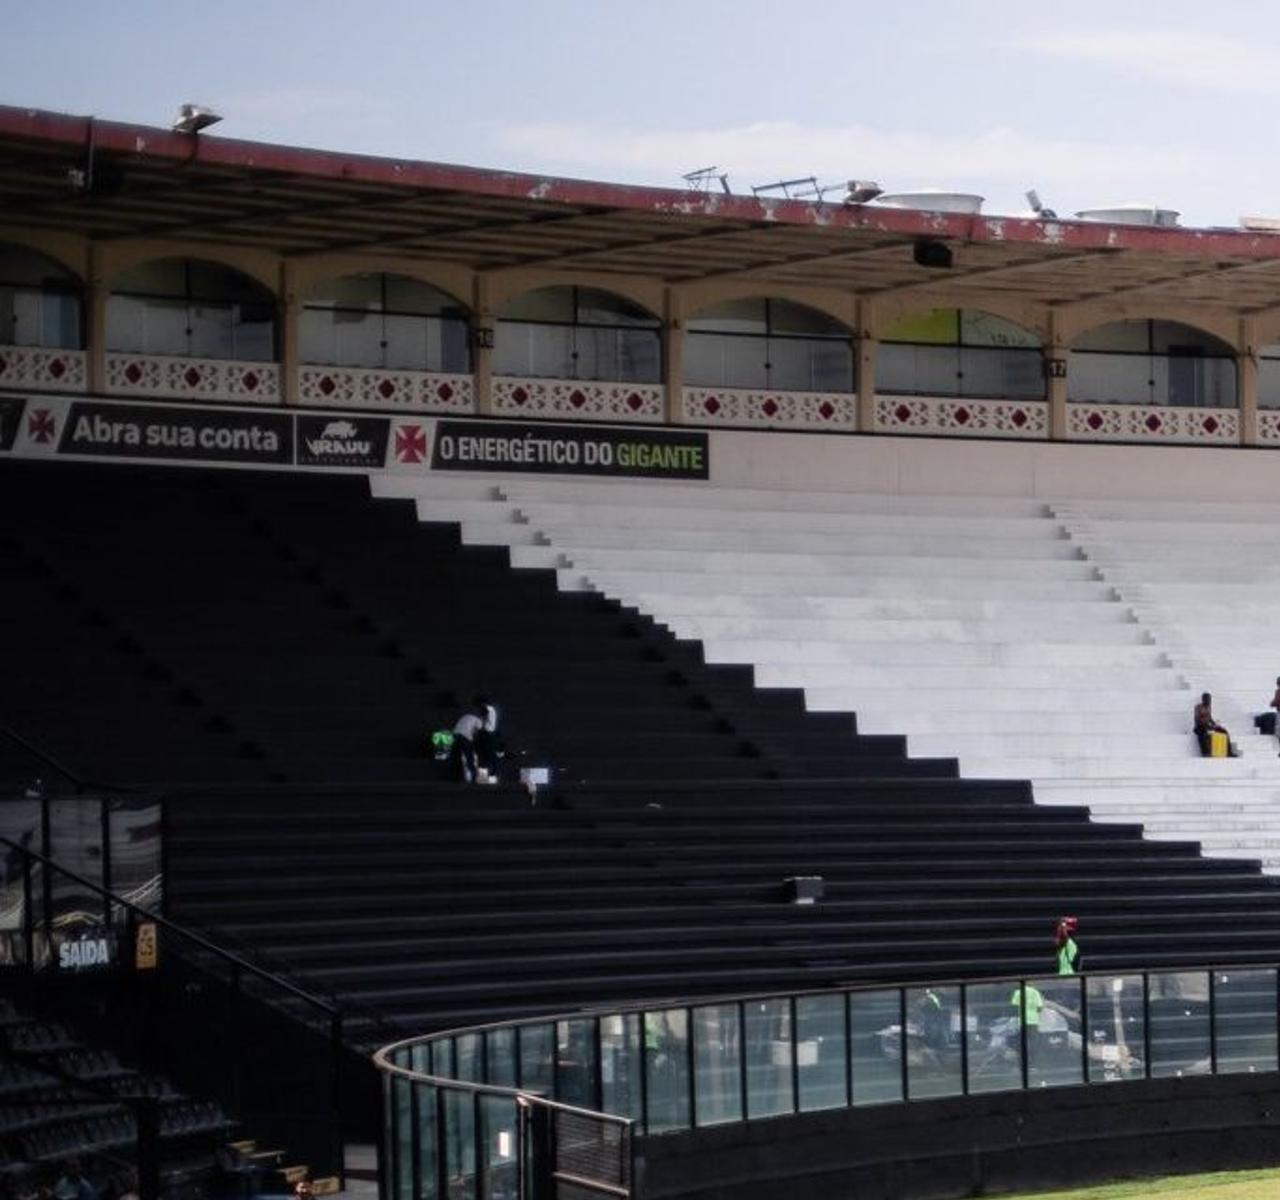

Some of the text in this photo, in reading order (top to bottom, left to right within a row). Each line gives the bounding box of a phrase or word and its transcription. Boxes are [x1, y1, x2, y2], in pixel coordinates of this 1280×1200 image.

[72, 414, 279, 452] Abra sua conta
[440, 432, 703, 469] O ENERGÉTICO DO GIGANTE
[59, 934, 109, 968] SAÍDA
